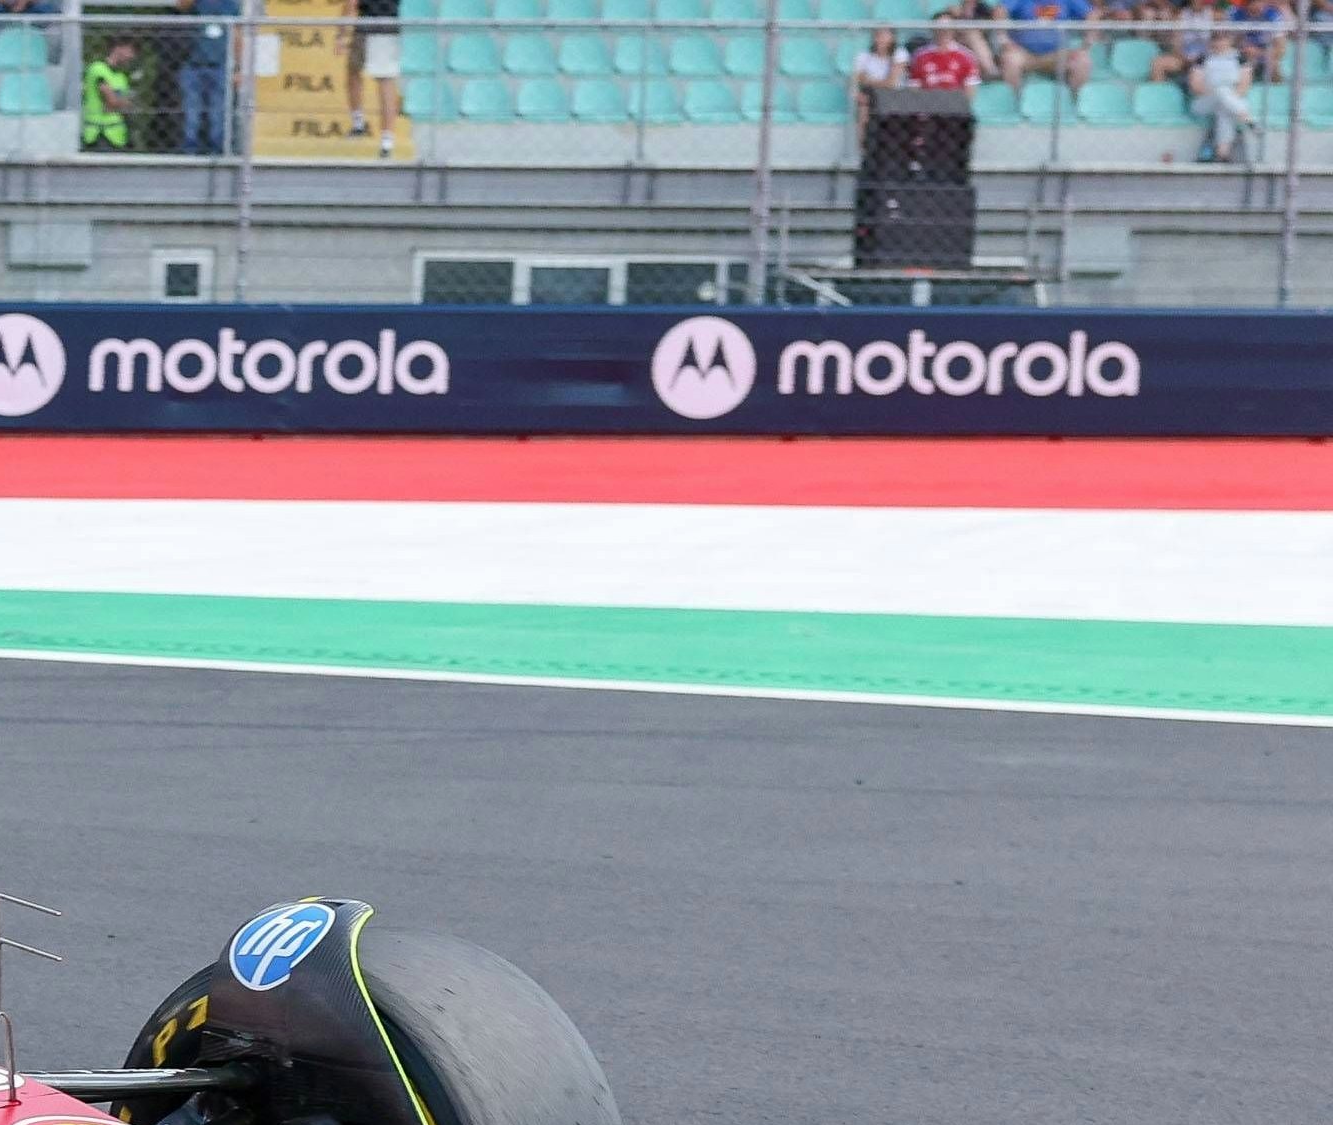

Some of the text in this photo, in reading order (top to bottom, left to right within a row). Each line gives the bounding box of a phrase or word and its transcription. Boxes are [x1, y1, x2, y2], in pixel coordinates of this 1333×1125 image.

[88, 329, 450, 394] motorola
[777, 330, 1141, 396] motorola
[236, 904, 324, 985] hp
